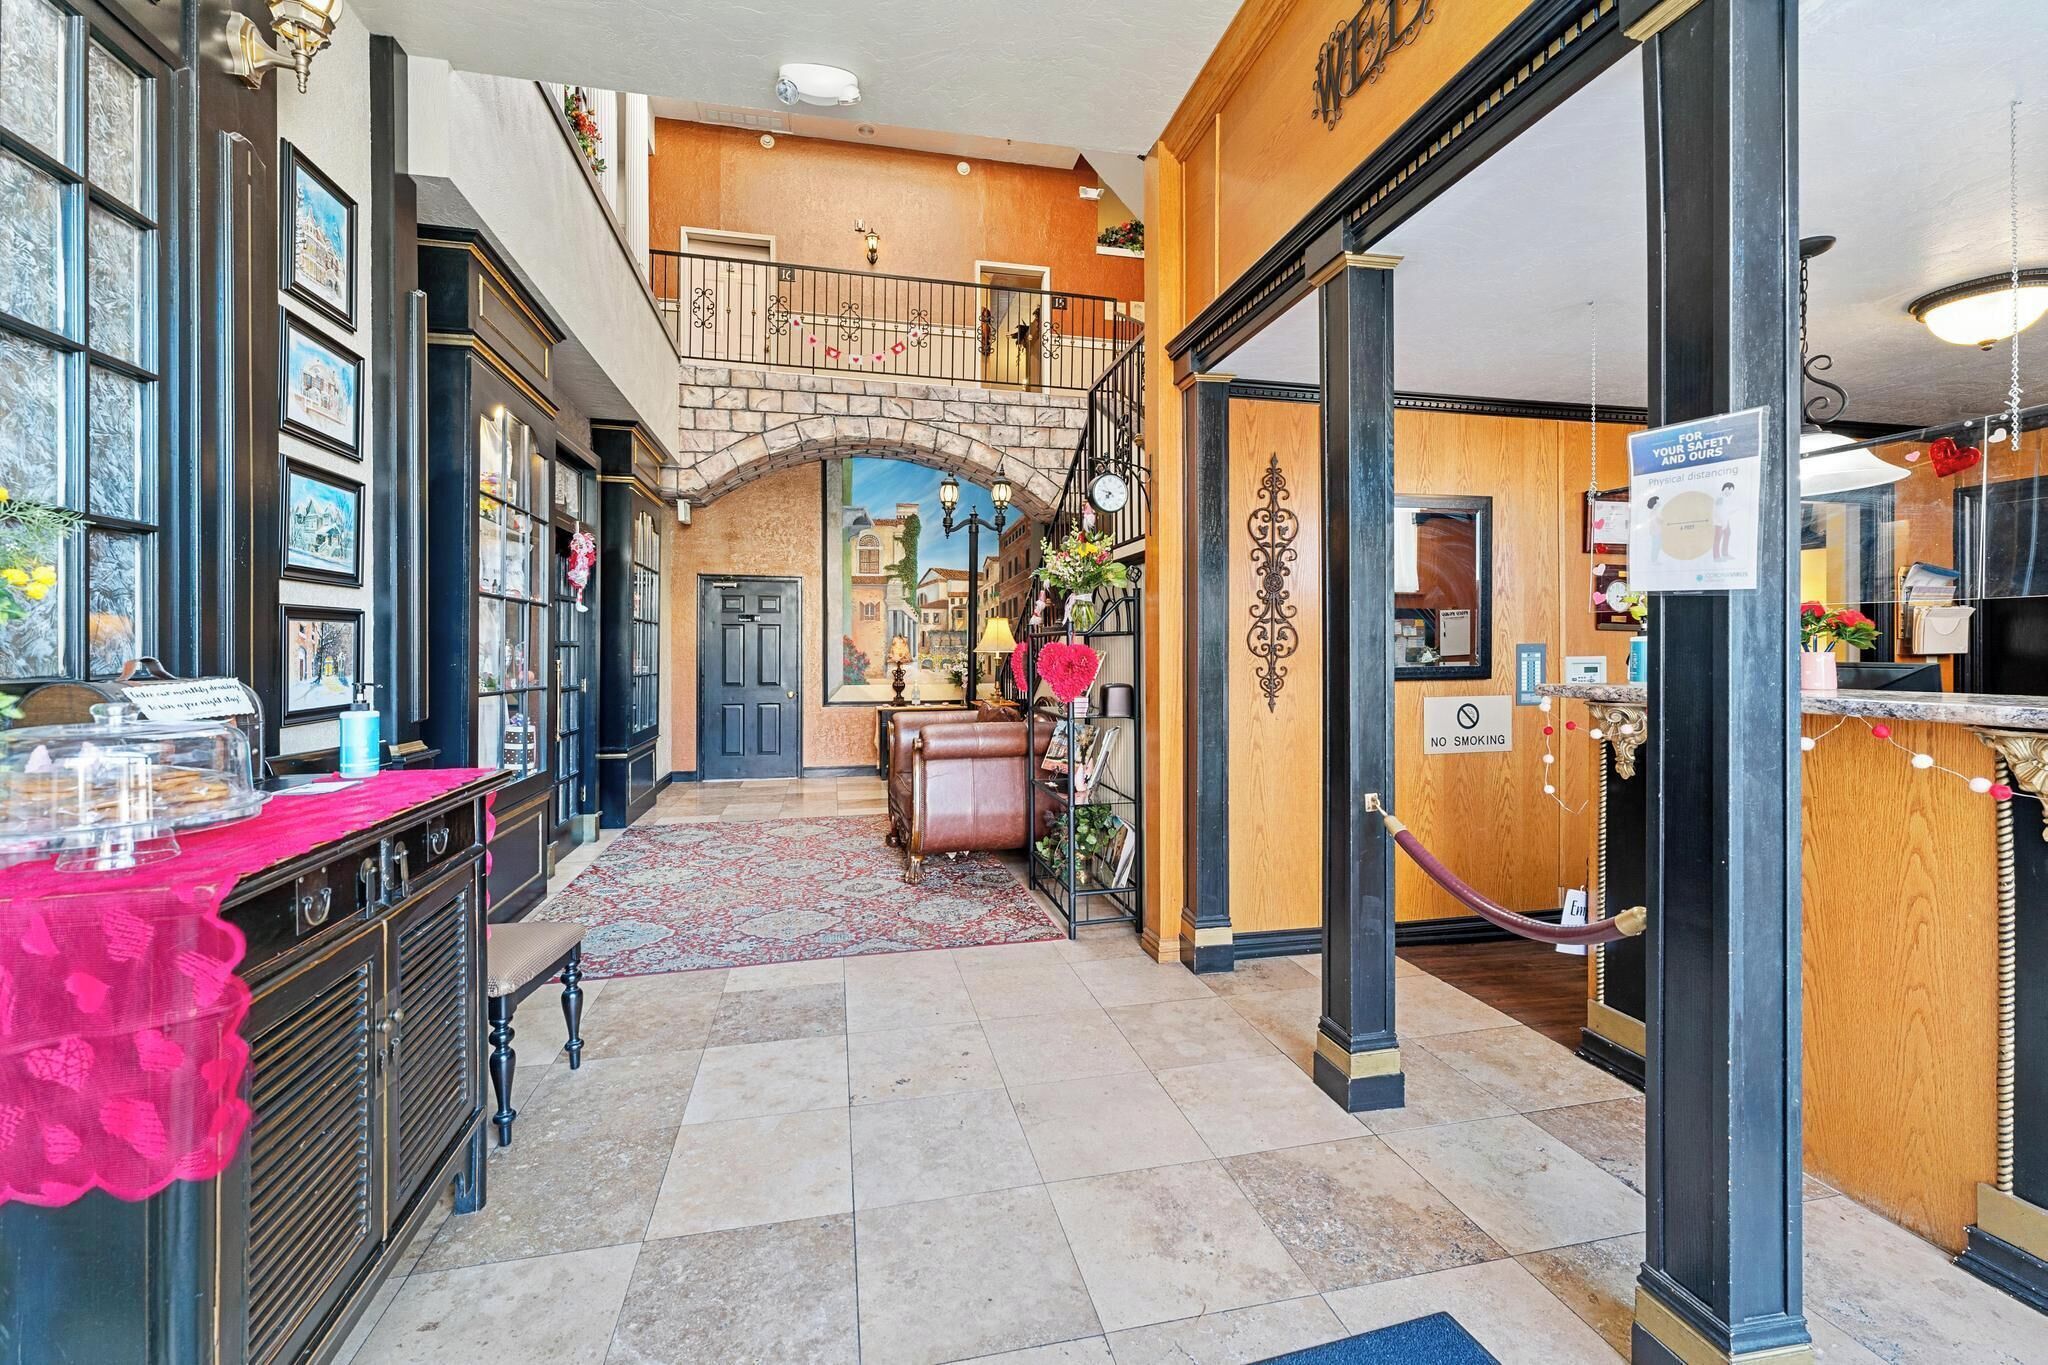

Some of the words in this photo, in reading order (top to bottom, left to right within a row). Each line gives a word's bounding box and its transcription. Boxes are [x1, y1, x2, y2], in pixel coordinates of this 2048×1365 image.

[1678, 431, 1703, 444] FOR
[1652, 444, 1685, 458] YOUR
[1687, 434, 1734, 452] SAFETY
[1661, 454, 1686, 466] AND
[1688, 447, 1724, 461] OURS
[1648, 473, 1685, 487] Physical
[1687, 466, 1739, 481] distancing
[172, 686, 209, 696] monthly
[1431, 737, 1447, 747] NO
[1454, 735, 1505, 746] SMOKING
